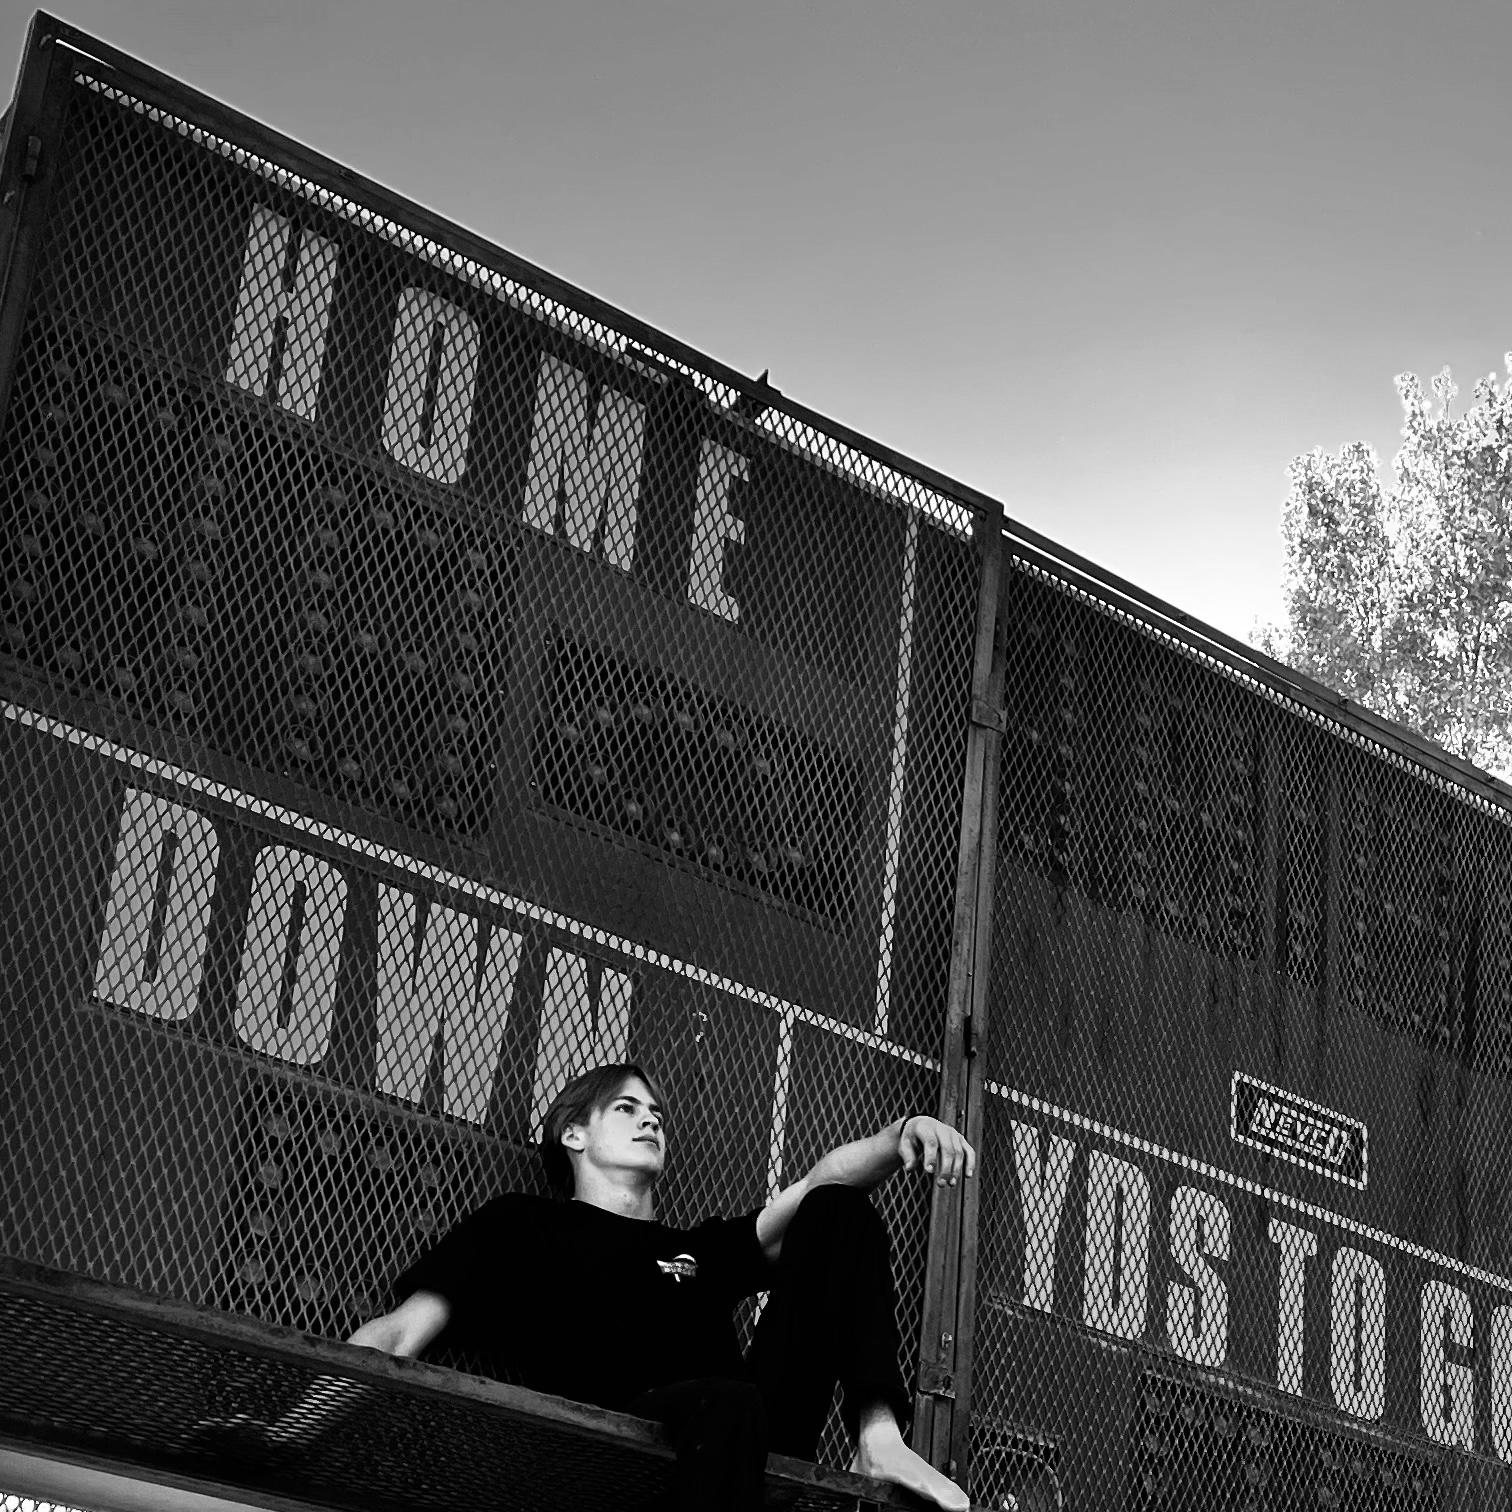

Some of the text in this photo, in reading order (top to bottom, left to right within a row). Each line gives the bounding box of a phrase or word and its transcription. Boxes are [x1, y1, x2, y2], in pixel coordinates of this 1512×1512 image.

[226, 203, 751, 625] HOME
[93, 787, 633, 1144] DOWN
[1010, 1119, 1232, 1368] YDS
[1267, 1217, 1387, 1422] TO
